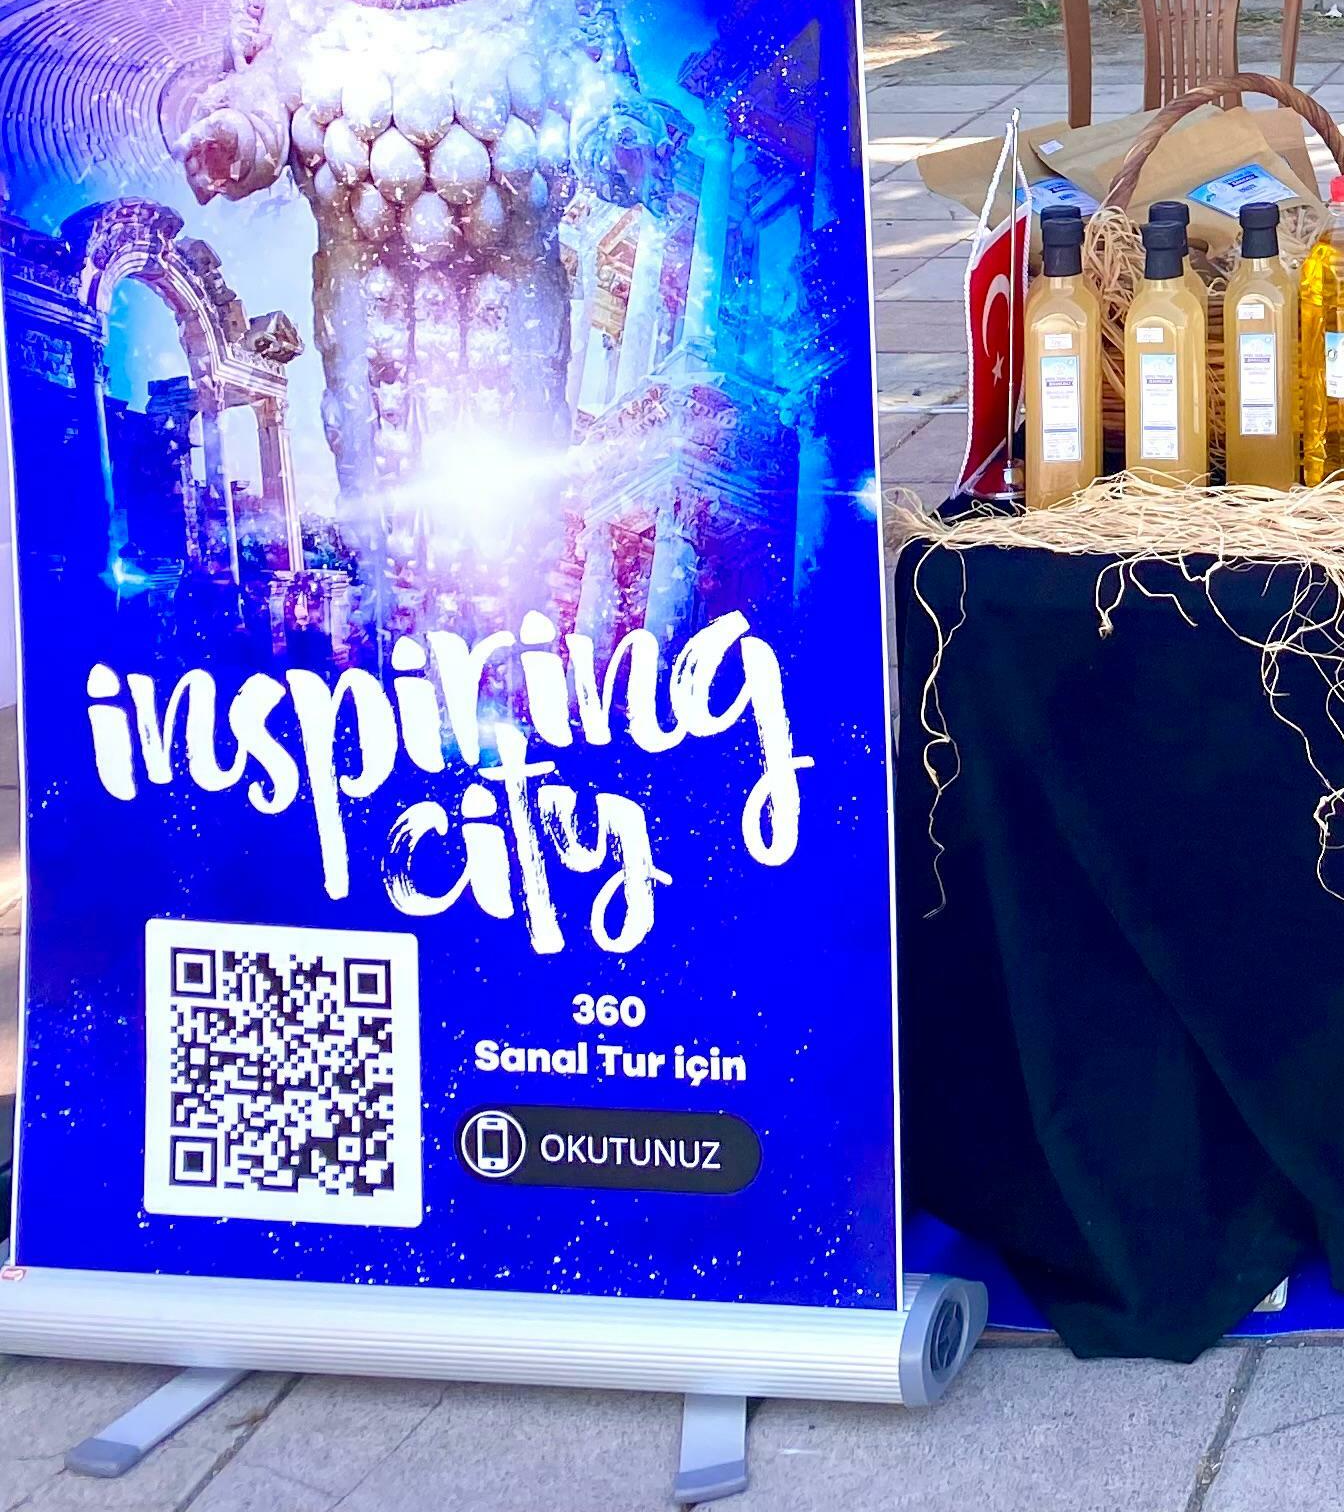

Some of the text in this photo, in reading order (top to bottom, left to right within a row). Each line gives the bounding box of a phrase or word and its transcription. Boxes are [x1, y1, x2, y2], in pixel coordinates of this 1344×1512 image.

[87, 611, 813, 899] inspiring
[384, 722, 672, 954] city
[572, 994, 646, 1028] 360
[475, 1043, 747, 1087] Sanal Tur için
[541, 1134, 721, 1170] OKUTUNUZ
